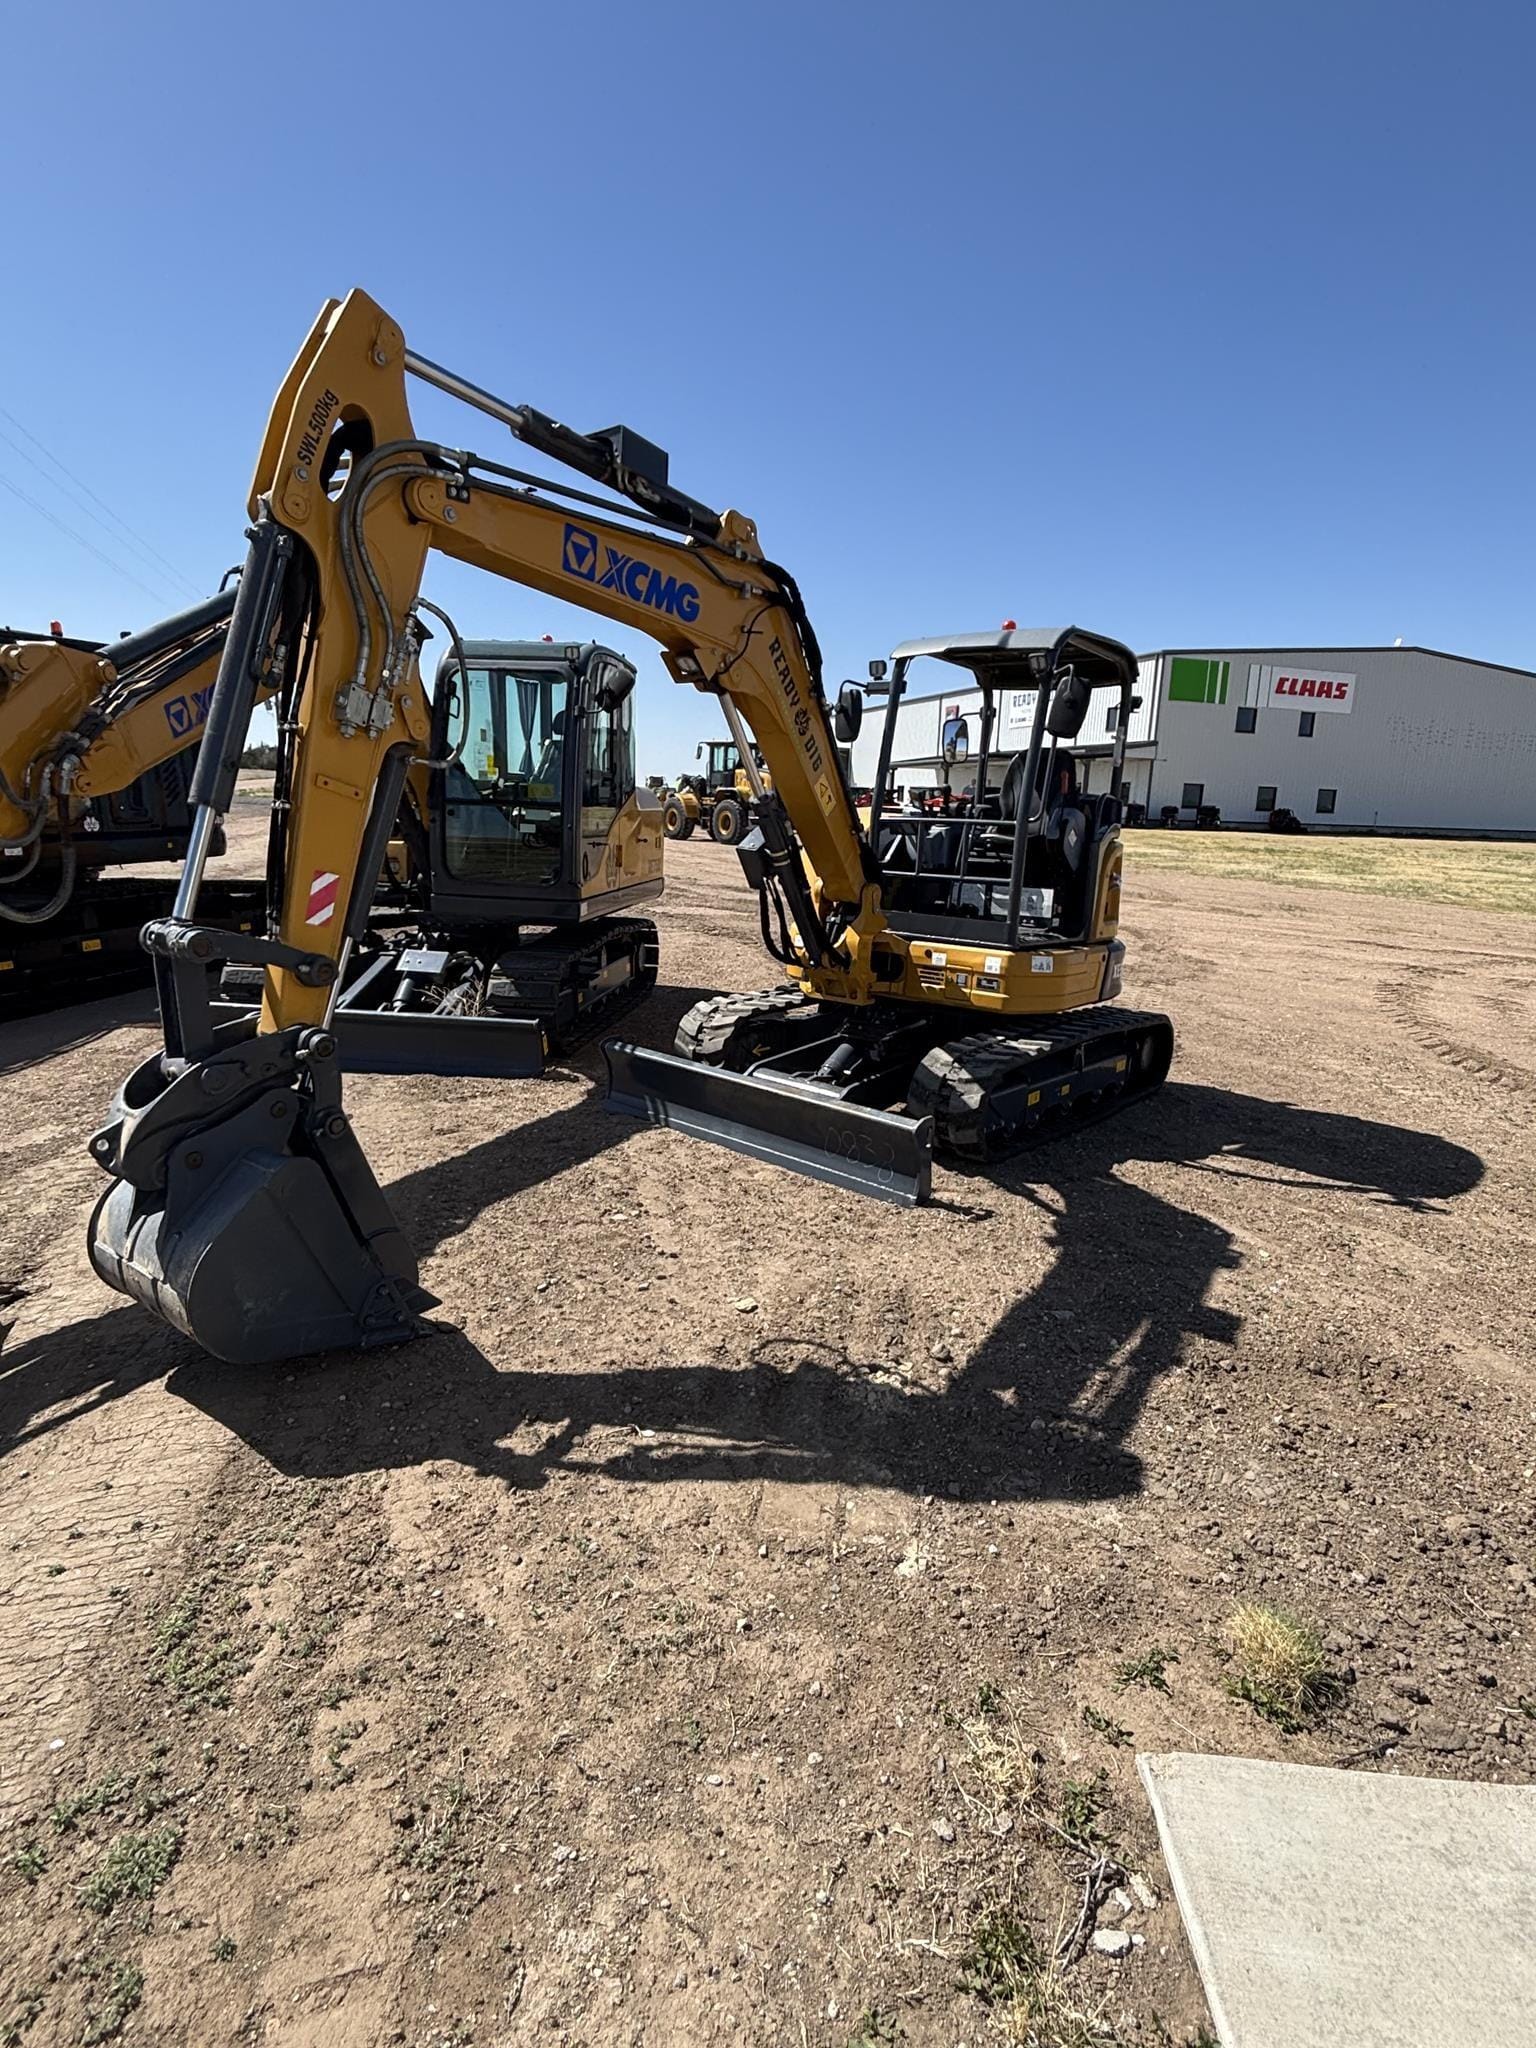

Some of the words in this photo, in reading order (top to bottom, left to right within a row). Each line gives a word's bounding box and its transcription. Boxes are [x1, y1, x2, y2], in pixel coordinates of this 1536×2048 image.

[596, 545, 701, 623] XCMG
[769, 636, 800, 706] READY
[804, 735, 823, 773] DIG
[1274, 676, 1349, 700] CLAAS
